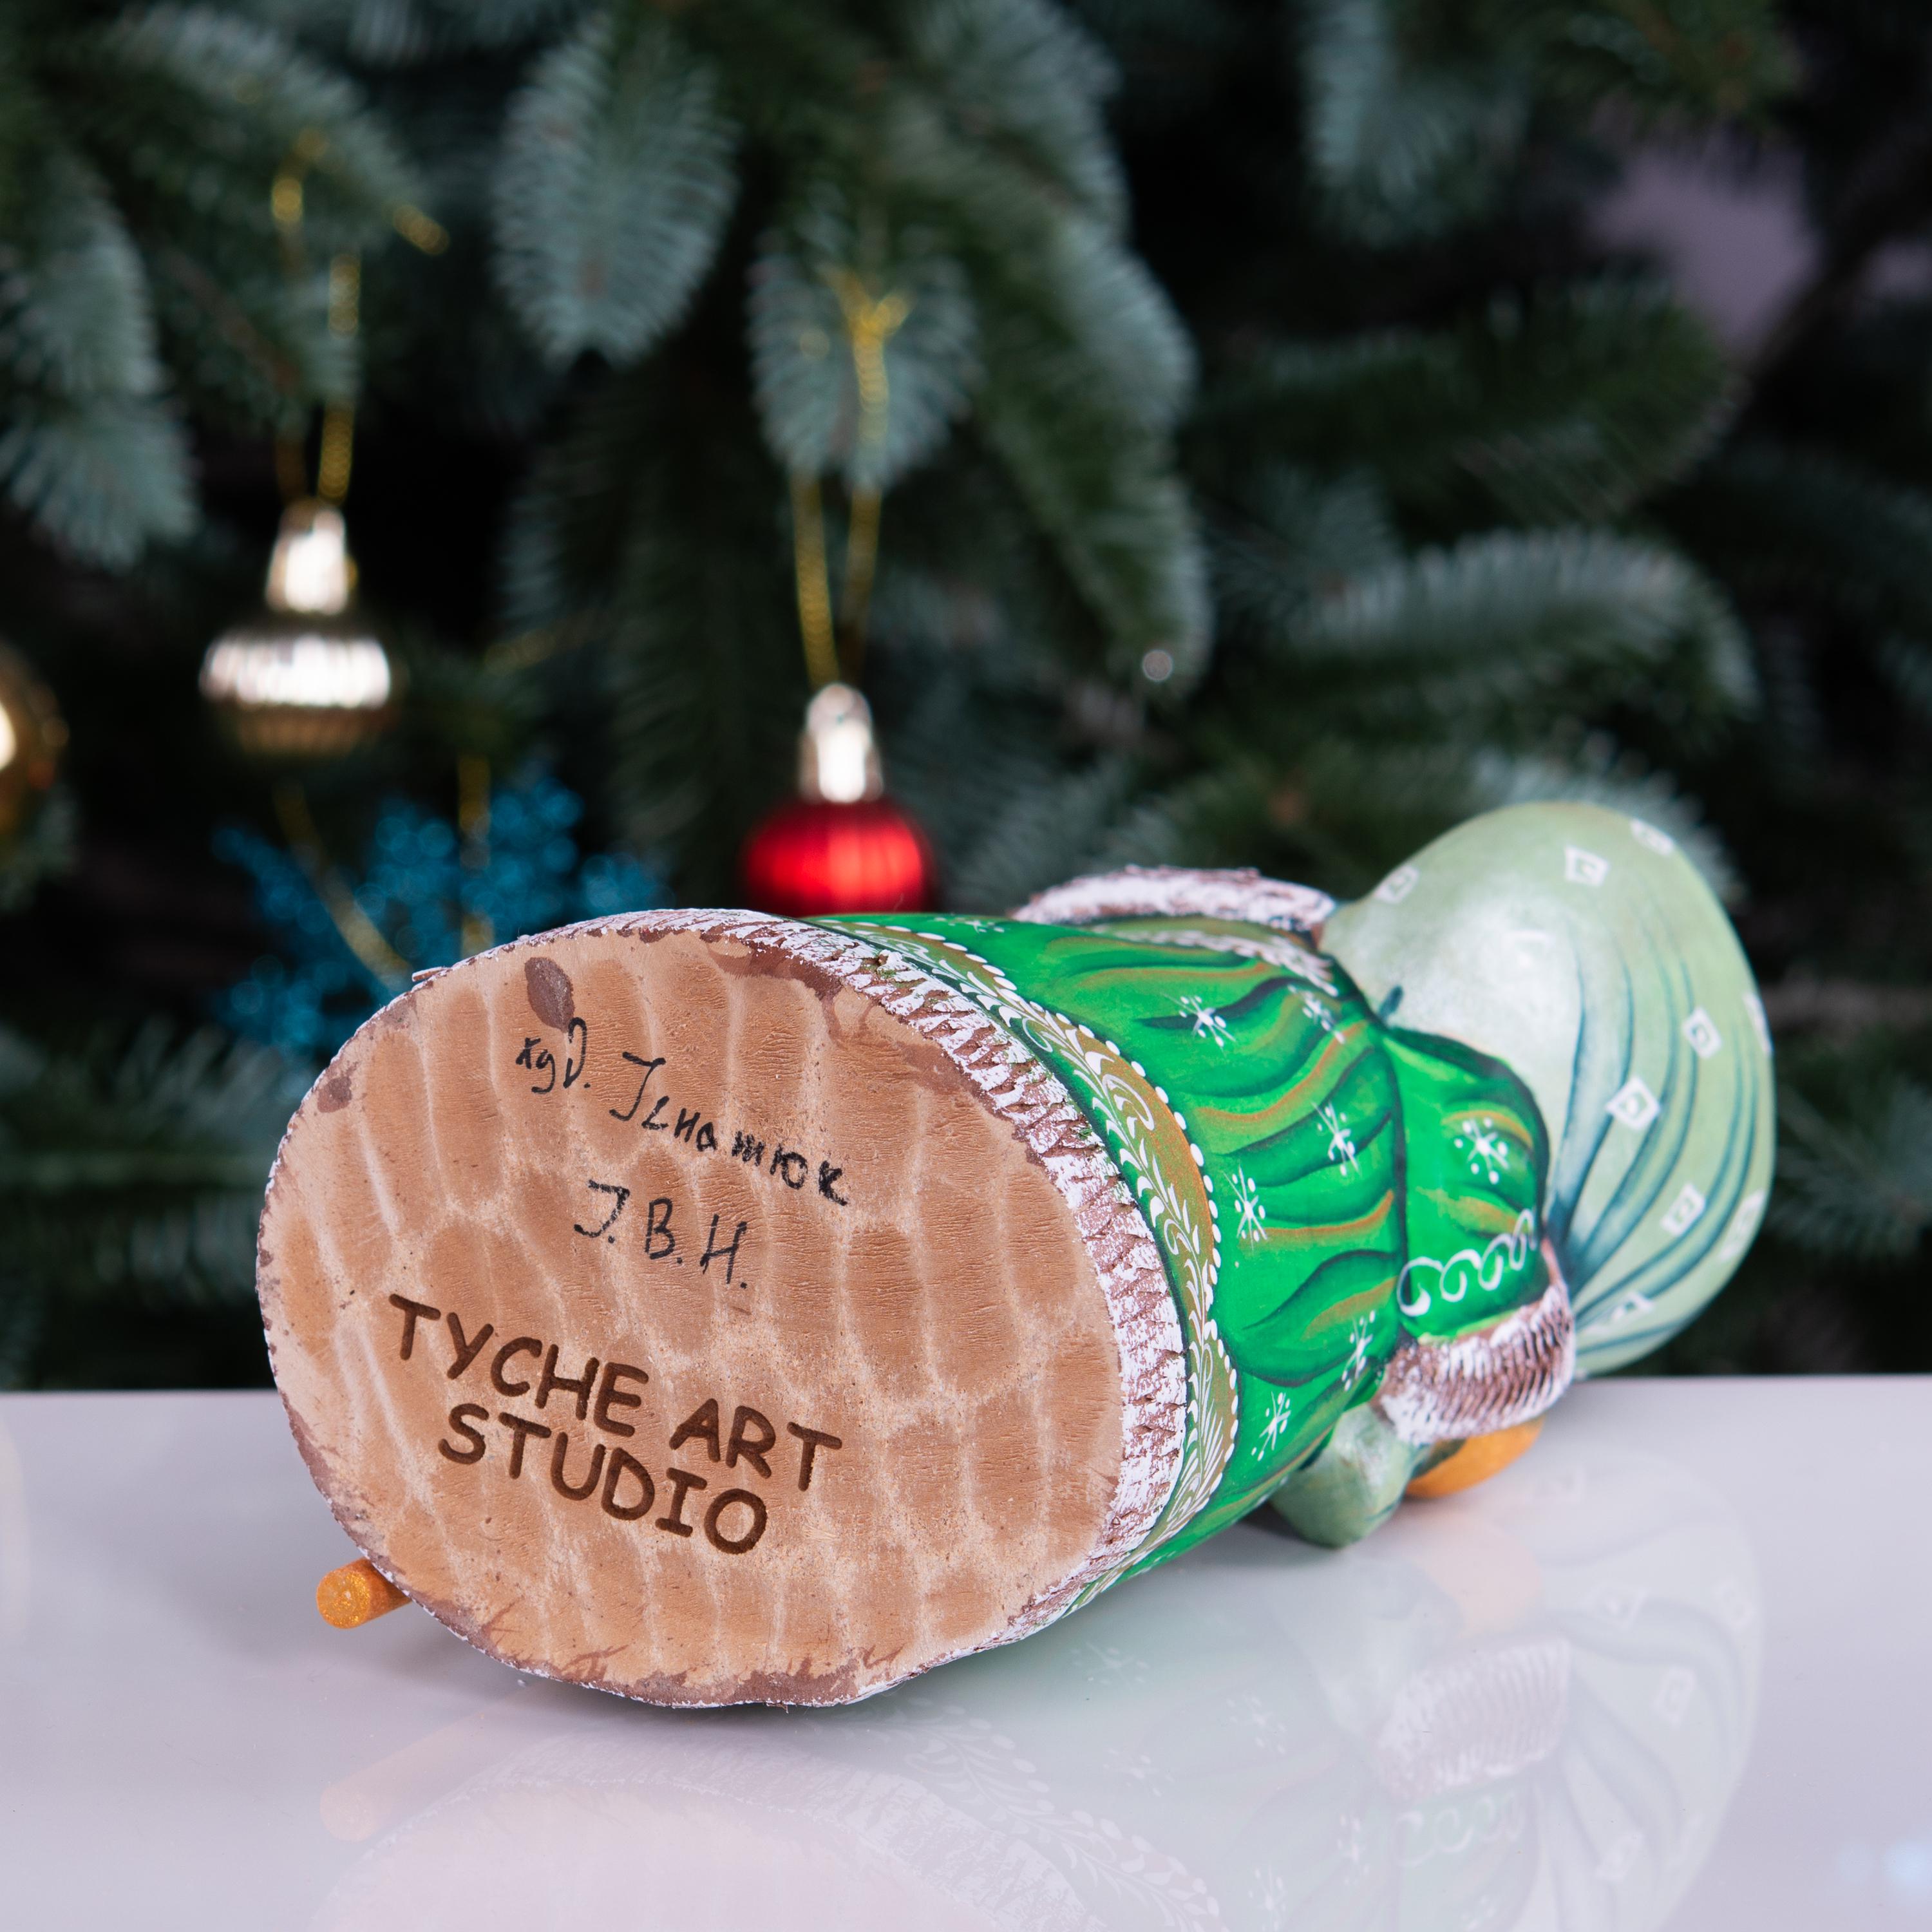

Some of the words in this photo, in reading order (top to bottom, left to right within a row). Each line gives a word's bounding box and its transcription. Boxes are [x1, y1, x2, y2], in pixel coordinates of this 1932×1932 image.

[388, 1293, 649, 1436] TYCHE
[668, 1398, 842, 1491] ART
[438, 1403, 769, 1554] STUDIO
